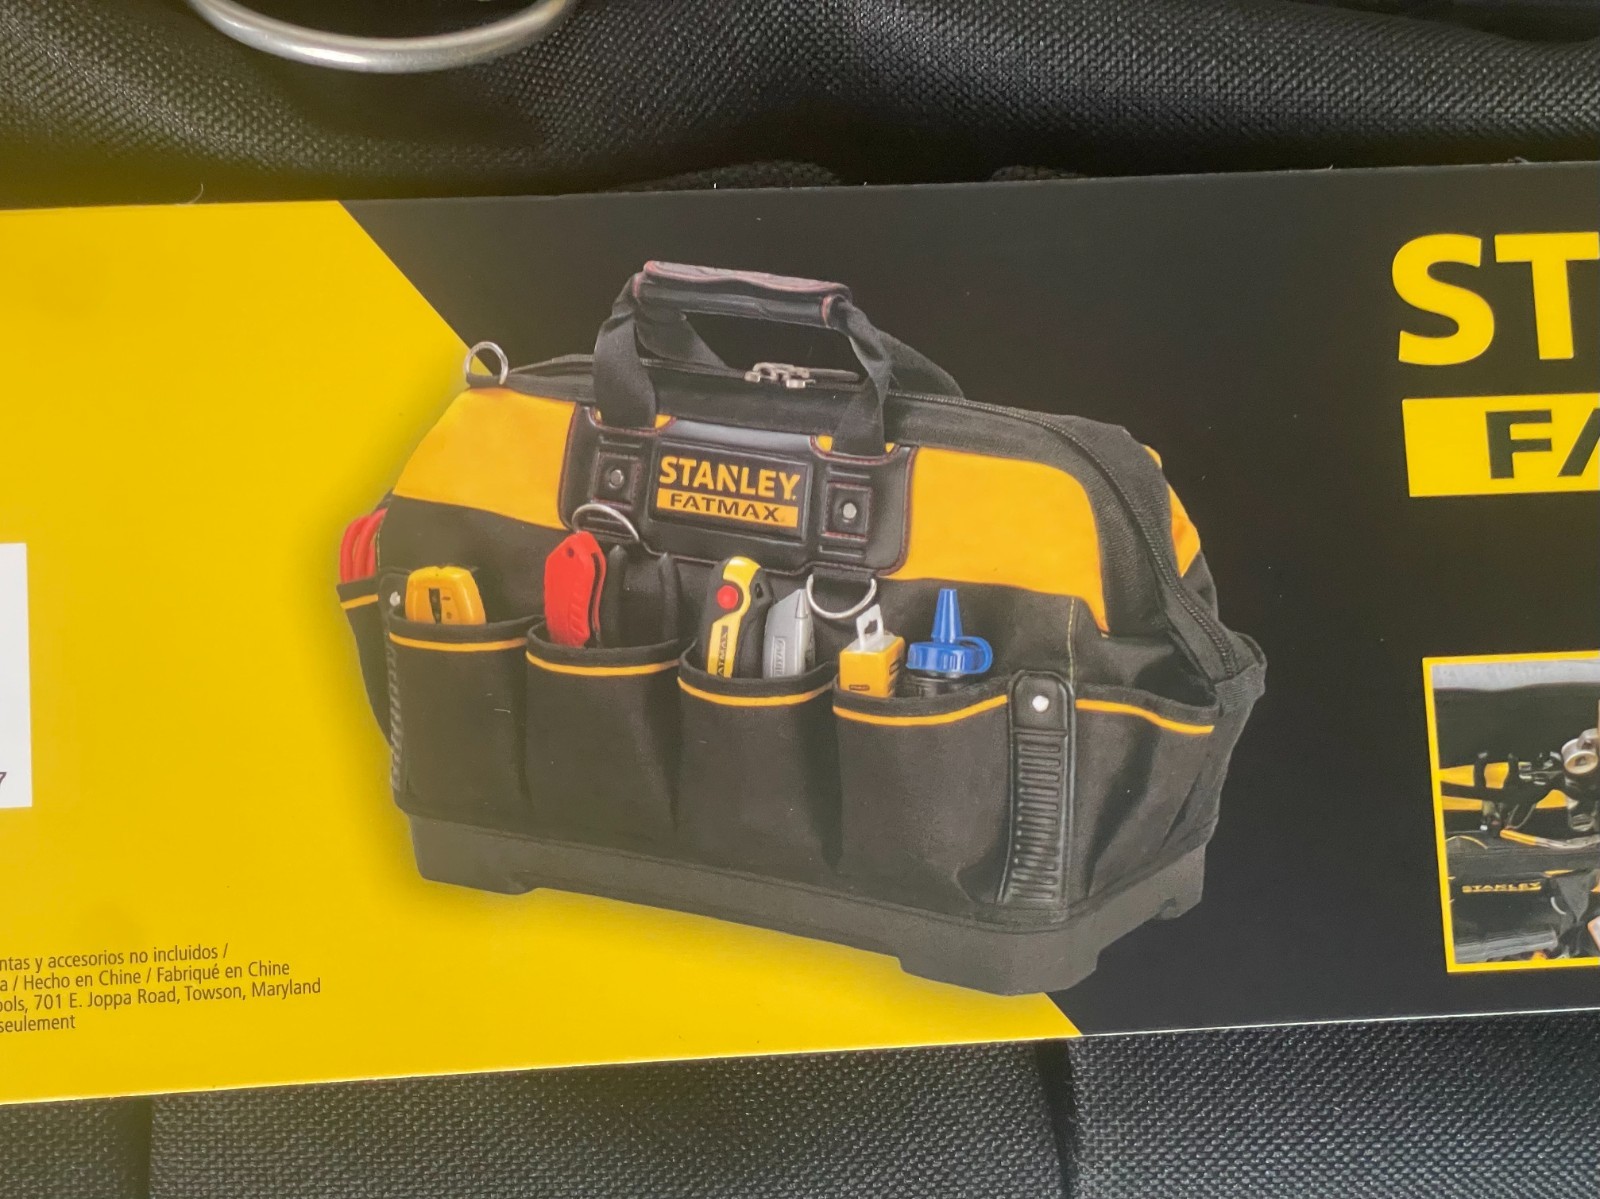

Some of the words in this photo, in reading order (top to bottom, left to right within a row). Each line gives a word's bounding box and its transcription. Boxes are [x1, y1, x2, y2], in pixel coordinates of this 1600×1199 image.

[659, 456, 801, 500] STANLEY
[670, 493, 780, 523] FATMAX
[0, 956, 30, 971] ntas
[35, 957, 43, 974] y
[48, 949, 124, 969] accesorios
[129, 950, 149, 964] no
[153, 943, 218, 963] incluidos
[24, 971, 70, 991] Hecho
[75, 974, 93, 987] en
[98, 969, 141, 986] Chine
[157, 963, 220, 984] Fabriqué
[225, 966, 243, 979] en
[248, 960, 290, 977] Chine
[0, 995, 28, 1014] ols,
[34, 993, 61, 1010] 701
[69, 992, 82, 1008] E.
[87, 990, 132, 1010] Joppa
[137, 987, 181, 1005] Road,
[184, 982, 246, 1002] Towson,
[251, 977, 321, 999] Maryland
[0, 1014, 76, 1033] seulement
